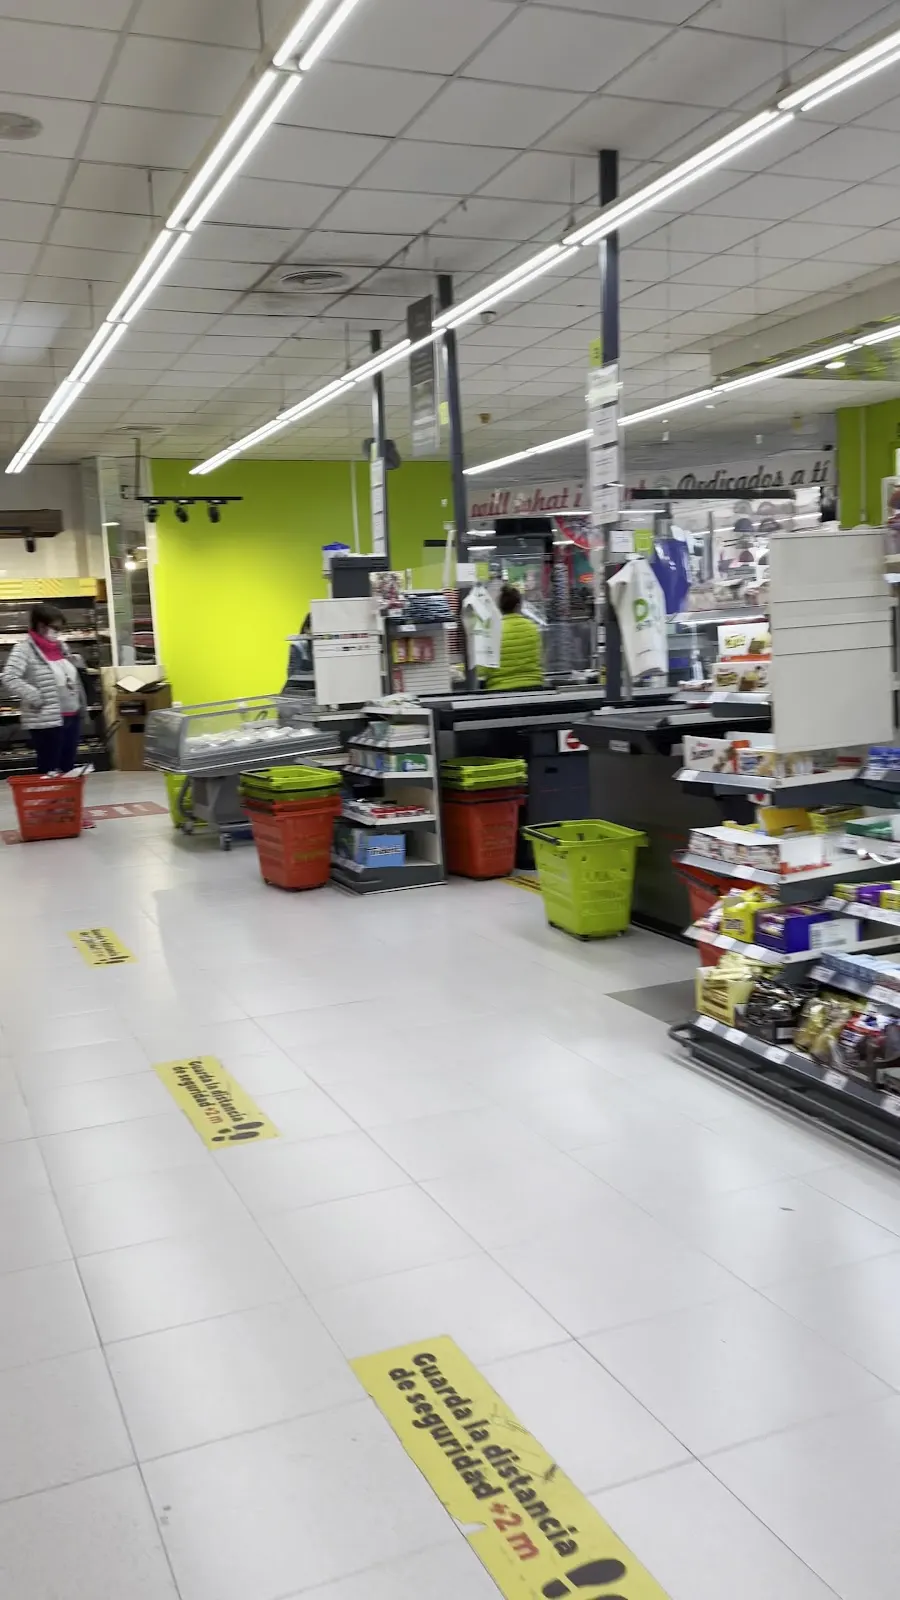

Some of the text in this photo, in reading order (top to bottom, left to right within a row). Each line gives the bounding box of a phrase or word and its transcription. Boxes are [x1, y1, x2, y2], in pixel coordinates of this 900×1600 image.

[789, 470, 806, 486] a
[172, 1066, 189, 1074] de
[177, 1074, 216, 1108] seguridad
[188, 1060, 247, 1122] Guarda la distancia
[388, 1366, 417, 1392] de
[406, 1391, 504, 1501] seguridad
[506, 1531, 540, 1561] m
[412, 1352, 579, 1558] Guarda la distancia
